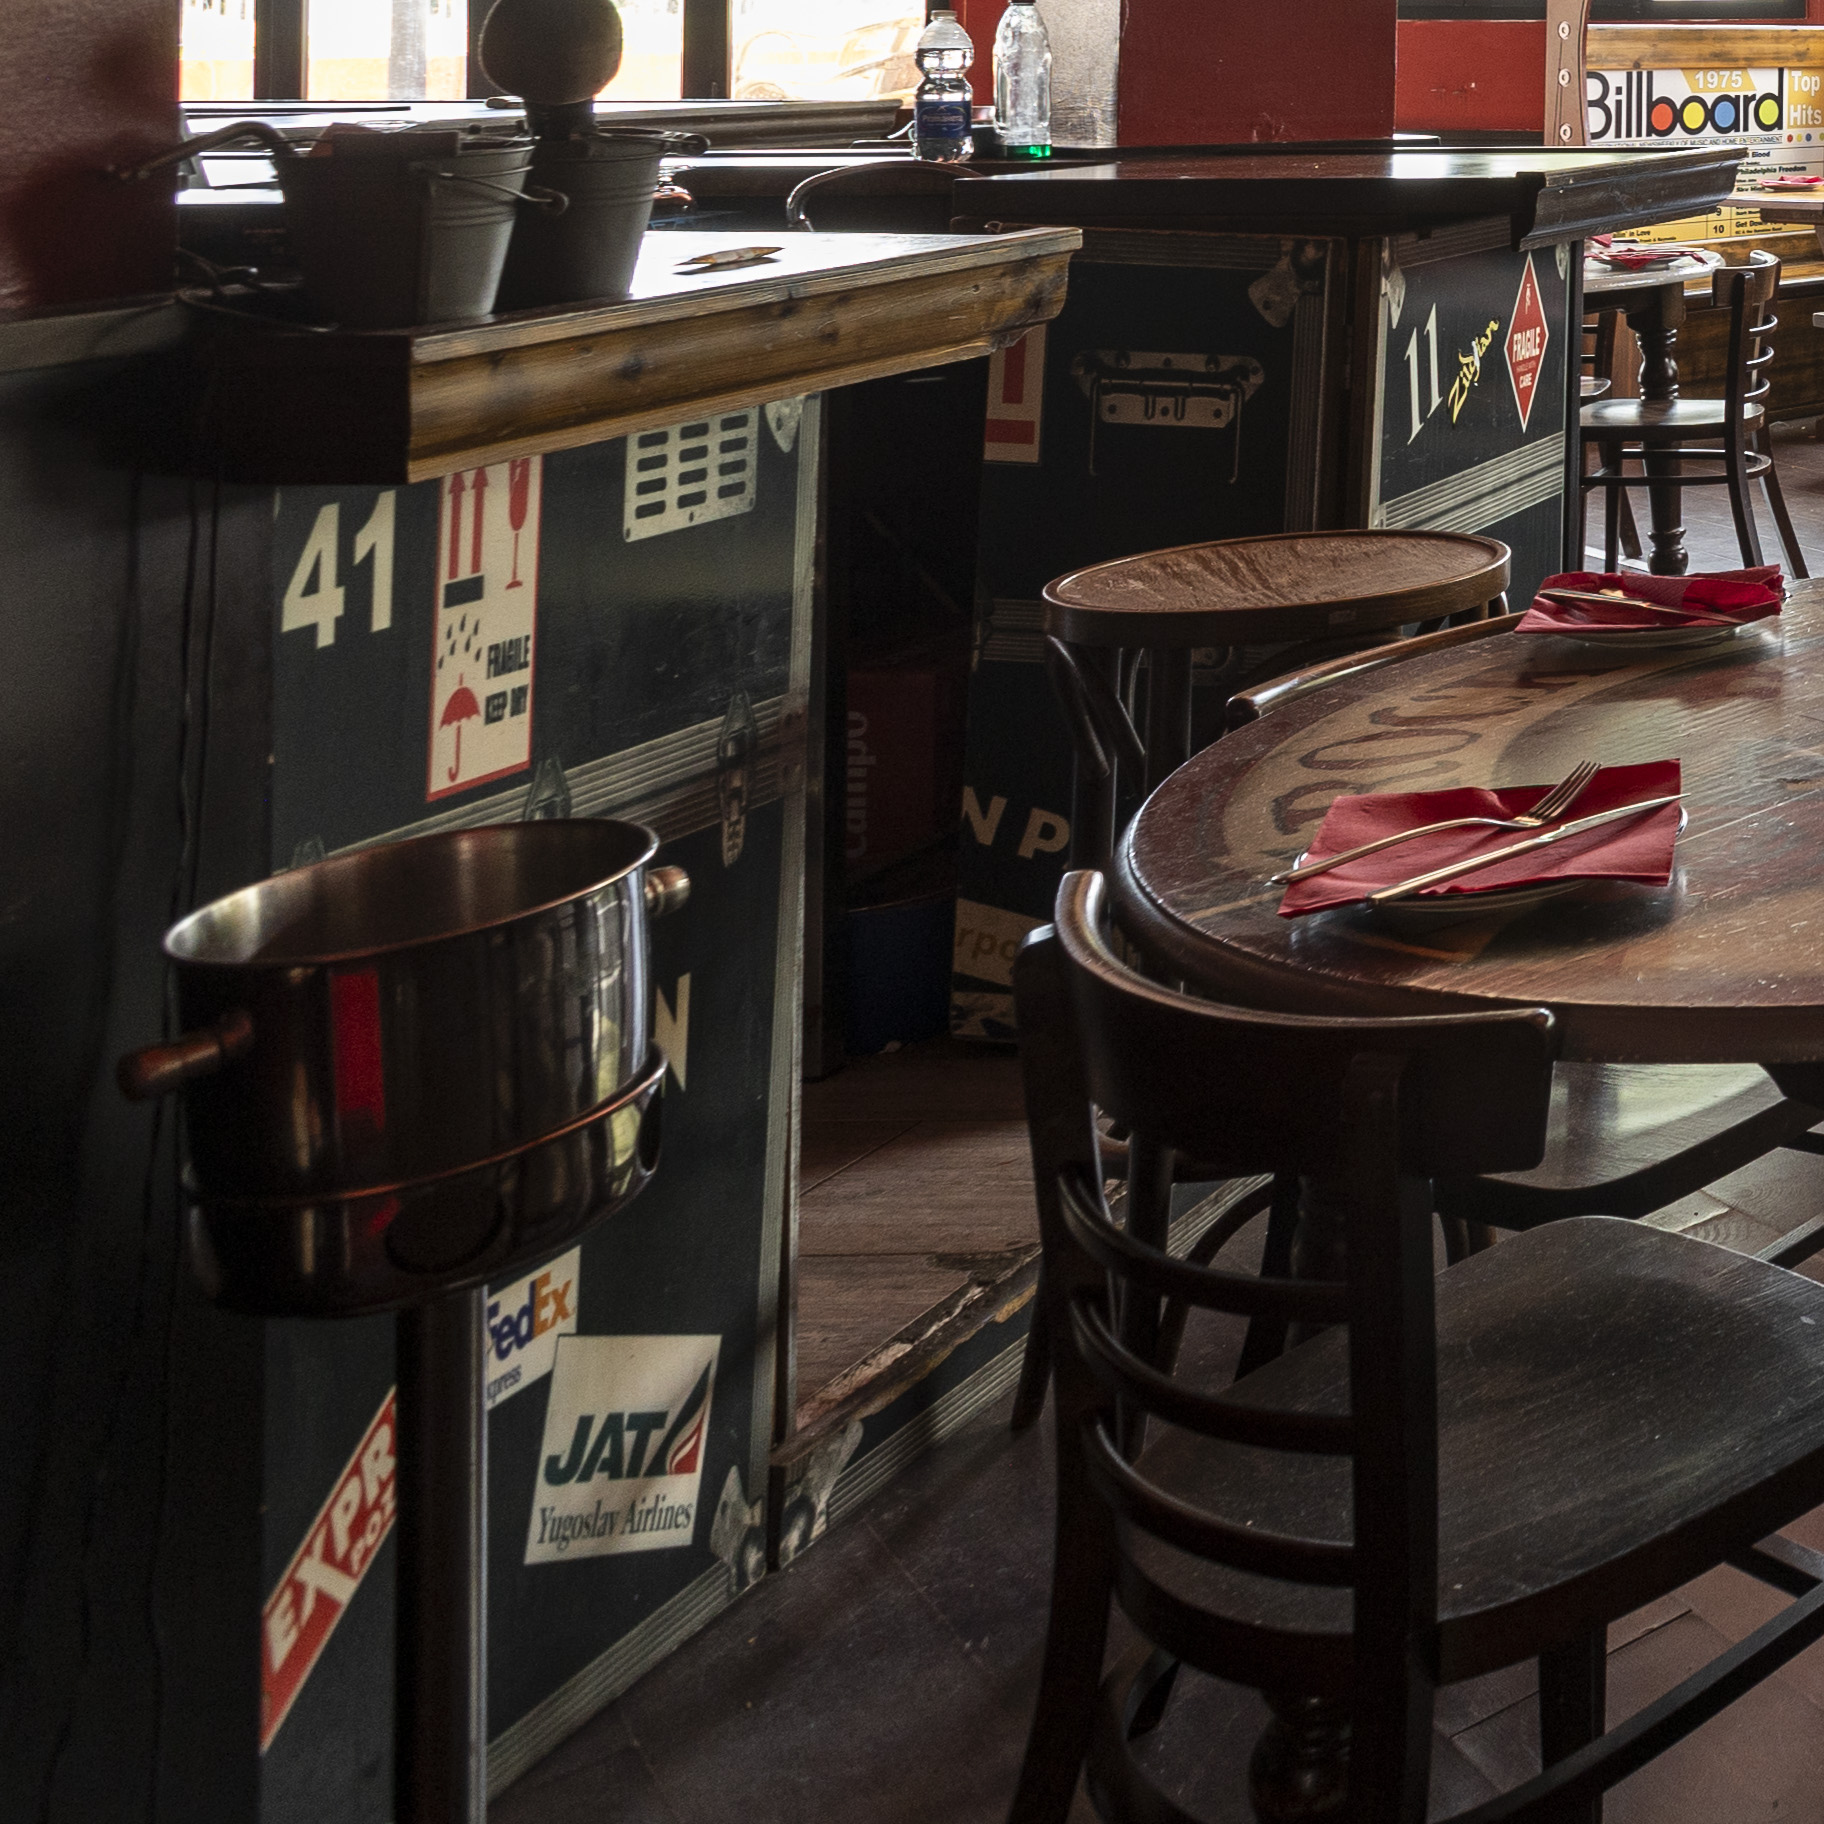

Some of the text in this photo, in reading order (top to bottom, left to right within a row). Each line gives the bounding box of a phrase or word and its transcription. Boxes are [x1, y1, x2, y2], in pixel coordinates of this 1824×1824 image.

[1694, 70, 1742, 90] 1975
[1791, 70, 1821, 96] Top
[1587, 68, 1783, 140] Billboard
[1789, 104, 1823, 126] Hits
[1713, 224, 1725, 234] 10
[1512, 326, 1541, 363] FRAGILE
[281, 489, 397, 650] 41
[486, 634, 531, 680] FRAGILE
[484, 690, 508, 726] KEEP
[543, 1411, 669, 1486] JAT
[537, 1494, 692, 1551] Yugoslav Airlines
